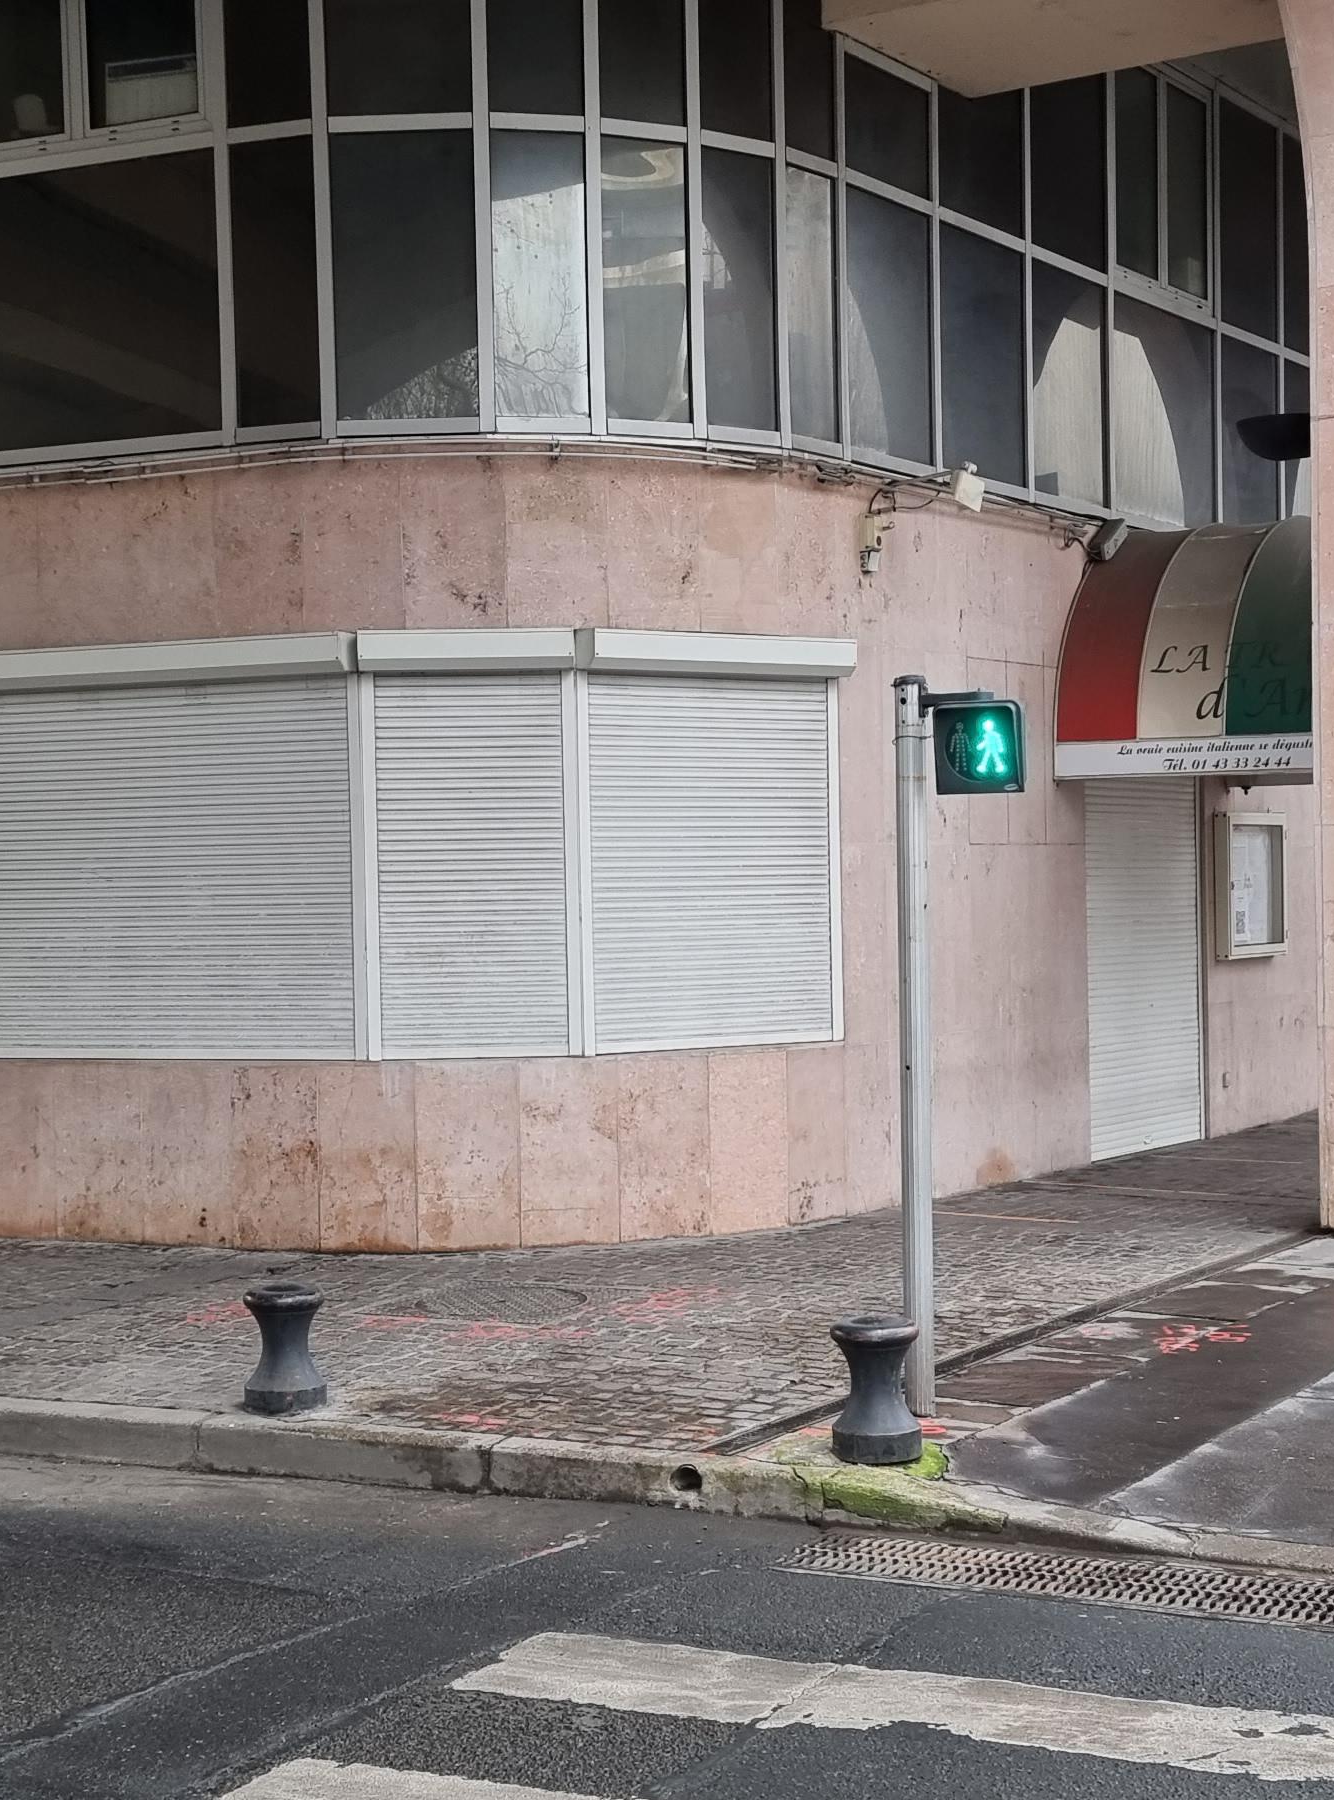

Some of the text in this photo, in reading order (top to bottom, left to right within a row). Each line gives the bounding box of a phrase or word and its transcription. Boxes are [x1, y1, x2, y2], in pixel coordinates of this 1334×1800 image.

[1150, 644, 1211, 674] LA
[1117, 744, 1133, 756] La
[1167, 742, 1204, 754] cuisine
[1207, 741, 1255, 752] italienne
[1163, 756, 1291, 771] Tél. 01 43 33 24 44
